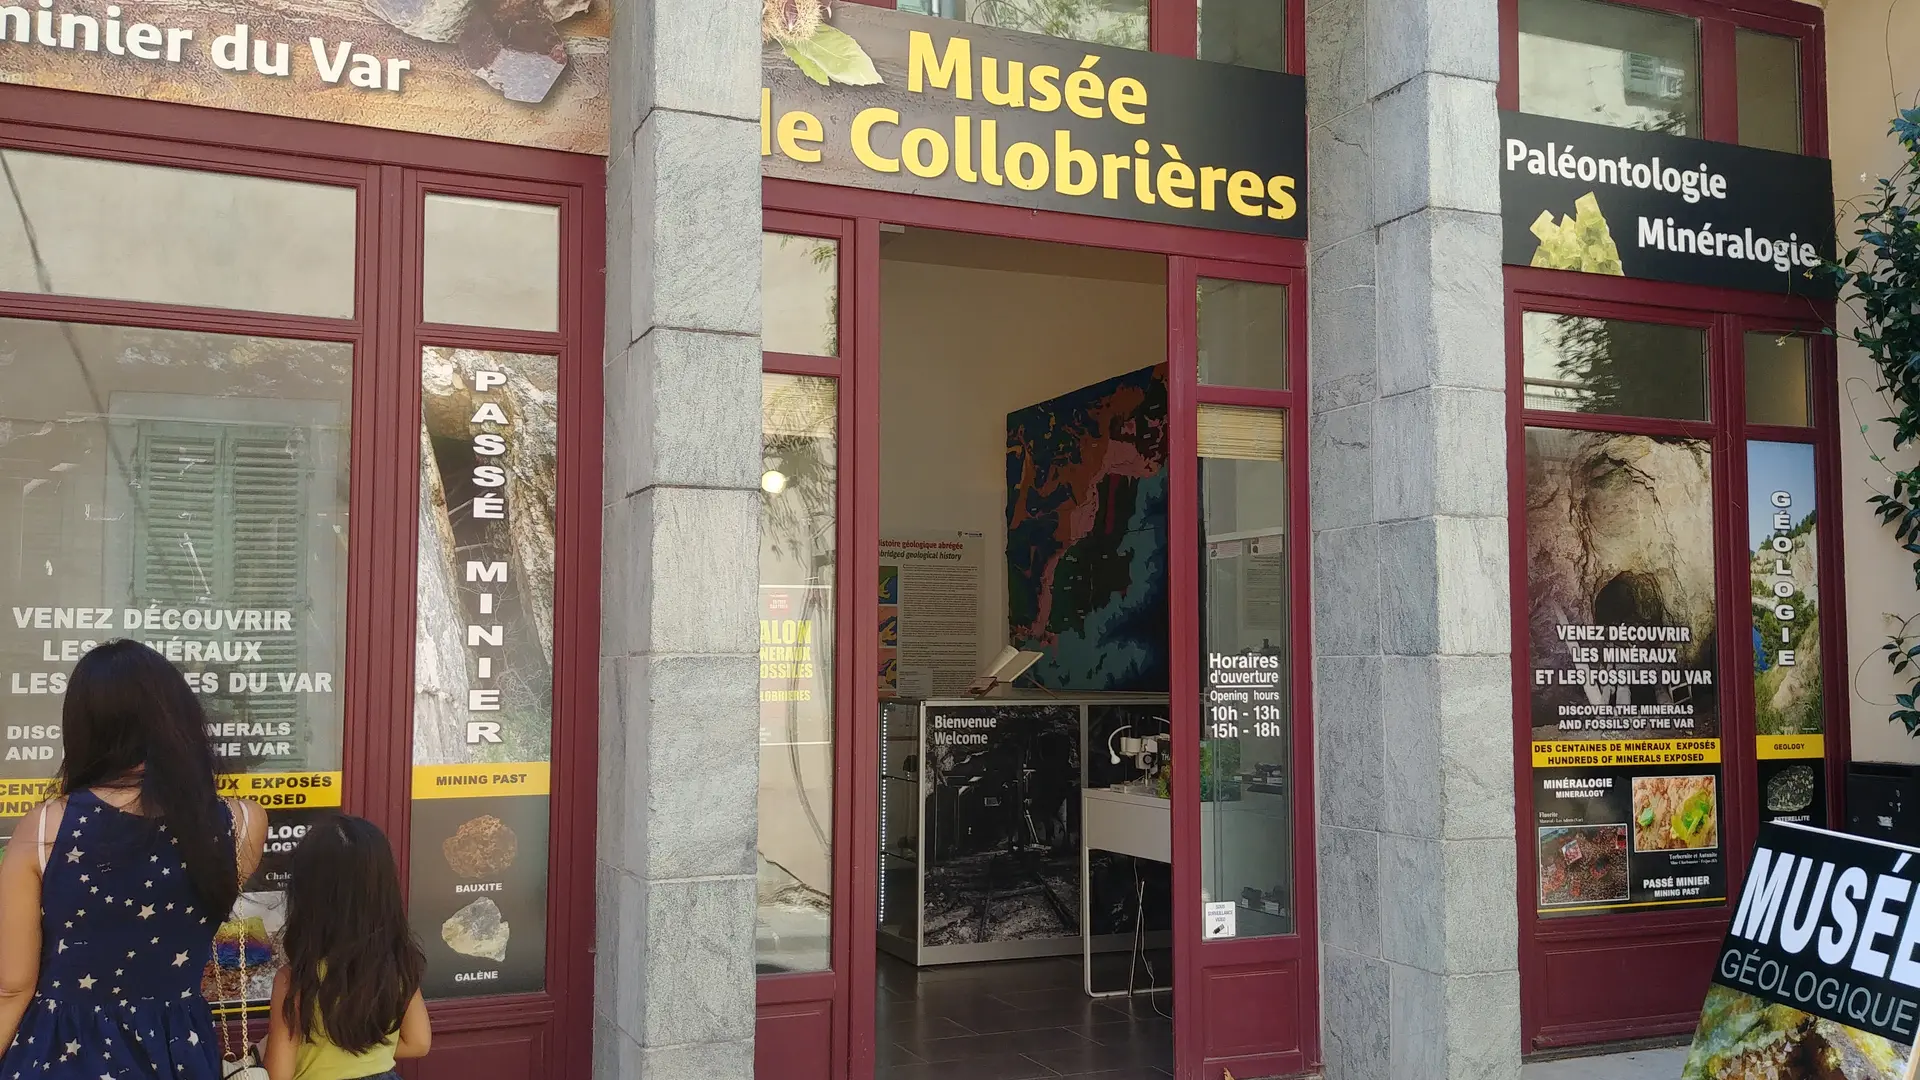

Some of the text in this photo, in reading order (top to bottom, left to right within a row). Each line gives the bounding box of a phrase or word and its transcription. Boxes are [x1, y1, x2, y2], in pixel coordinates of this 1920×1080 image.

[210, 24, 290, 76] du
[309, 37, 411, 91] Var
[908, 30, 1147, 125] Musée
[850, 107, 1297, 220] Collobrières
[1506, 138, 1727, 203] Paléontologie
[1637, 216, 1819, 272] Minéralogie
[902, 540, 937, 550] géologique
[938, 541, 964, 551] abrégée
[466, 370, 509, 744] PASSÉ MINIER
[879, 550, 962, 561] bridged geological history
[1770, 490, 1796, 666] GÉOLOGIE
[12, 604, 292, 631] VENEZ DÉCOUVRIR
[760, 619, 812, 645] ALON
[1556, 622, 1690, 642] VENEZ DÉCOUVRIR
[140, 636, 262, 662] NÉRAUX
[760, 646, 811, 662] NERAUX
[1572, 644, 1677, 663] LES MINÉRAUX
[1209, 652, 1279, 669] Horaires
[760, 663, 813, 678] OSSILES
[1210, 670, 1279, 684] d'ouverture
[1535, 669, 1712, 685] ET LES FOSSILES DU VAR
[12, 672, 67, 694] LES
[229, 673, 267, 693] DU
[278, 672, 332, 693] VAR
[760, 690, 811, 702] LOBRIERES
[1210, 690, 1279, 703] Opening hours
[1210, 705, 1238, 721] 10h
[1253, 705, 1280, 720] 13h
[1558, 704, 1694, 716] DISCOVER THE MINERALS
[934, 715, 997, 729] Bienvenue
[1211, 722, 1238, 738] 15h
[1253, 722, 1280, 737] 18h
[1558, 718, 1694, 730] AND FOSSILS OF THE VAR
[7, 722, 291, 740] DISC NERALS
[934, 731, 988, 745] Welcome
[5, 746, 54, 761] AND
[212, 742, 241, 757] HE
[248, 742, 291, 756] VAR
[1534, 740, 1716, 753] DES CENTAINES DE MINÉRAUX EXPOSÉS
[1548, 753, 1704, 765] HUNDREDS OF MINERALS EXPOSED
[251, 773, 332, 790] EXPOSÉS
[436, 774, 527, 786] MINING PAST
[1543, 776, 1613, 789] MINÉRALOGIE
[223, 793, 307, 806] POSED
[1555, 789, 1605, 799] MINERALOGY
[455, 882, 503, 893] BAUXITE
[1643, 875, 1710, 889] PASSÉ MINIER
[1654, 887, 1700, 897] MINING PAST
[455, 970, 499, 982] GALÈNE
[1721, 948, 1918, 1036] GÉOLOGIQUE
